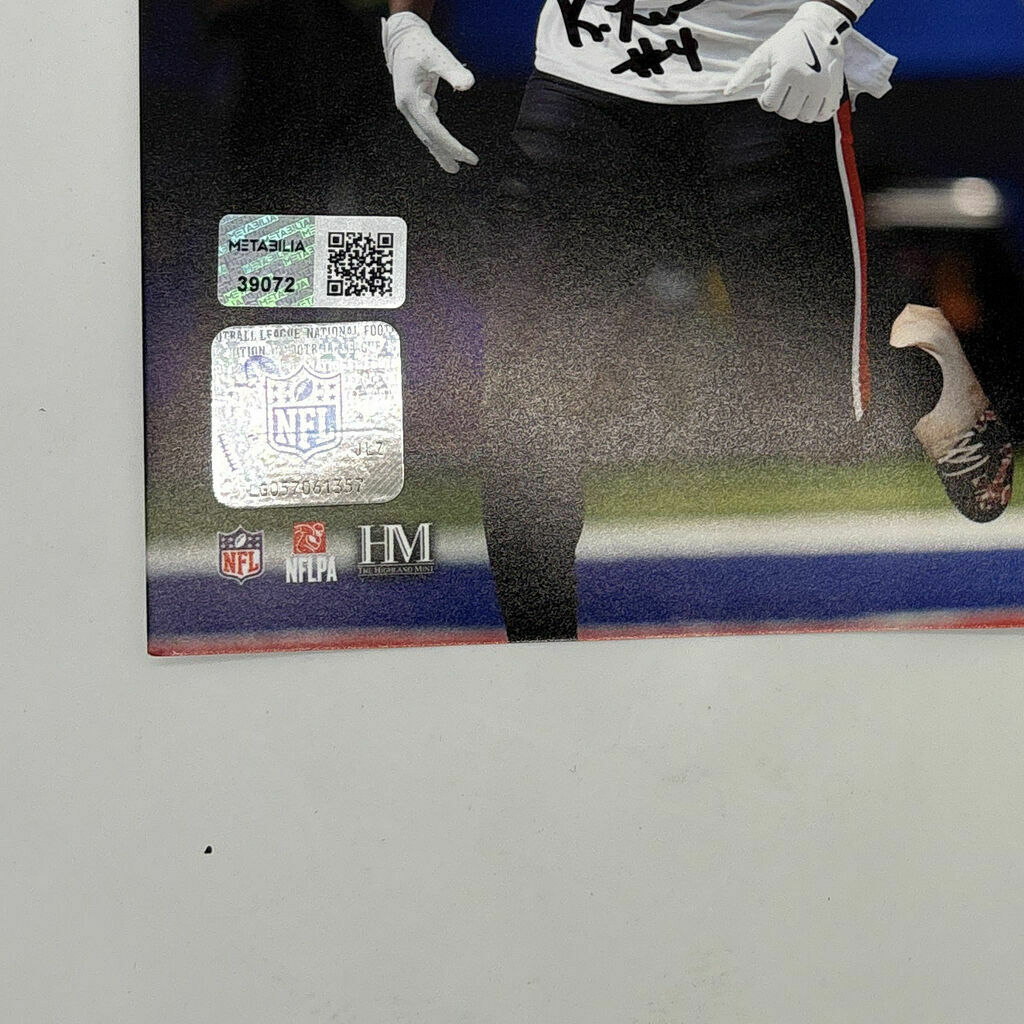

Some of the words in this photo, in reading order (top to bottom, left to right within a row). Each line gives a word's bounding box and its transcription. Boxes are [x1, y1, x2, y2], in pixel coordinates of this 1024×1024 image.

[610, 27, 703, 78] #4
[228, 239, 306, 253] METABILIA
[237, 276, 296, 293] 39072
[305, 325, 358, 339] NATIONAL
[273, 407, 337, 450] NFL
